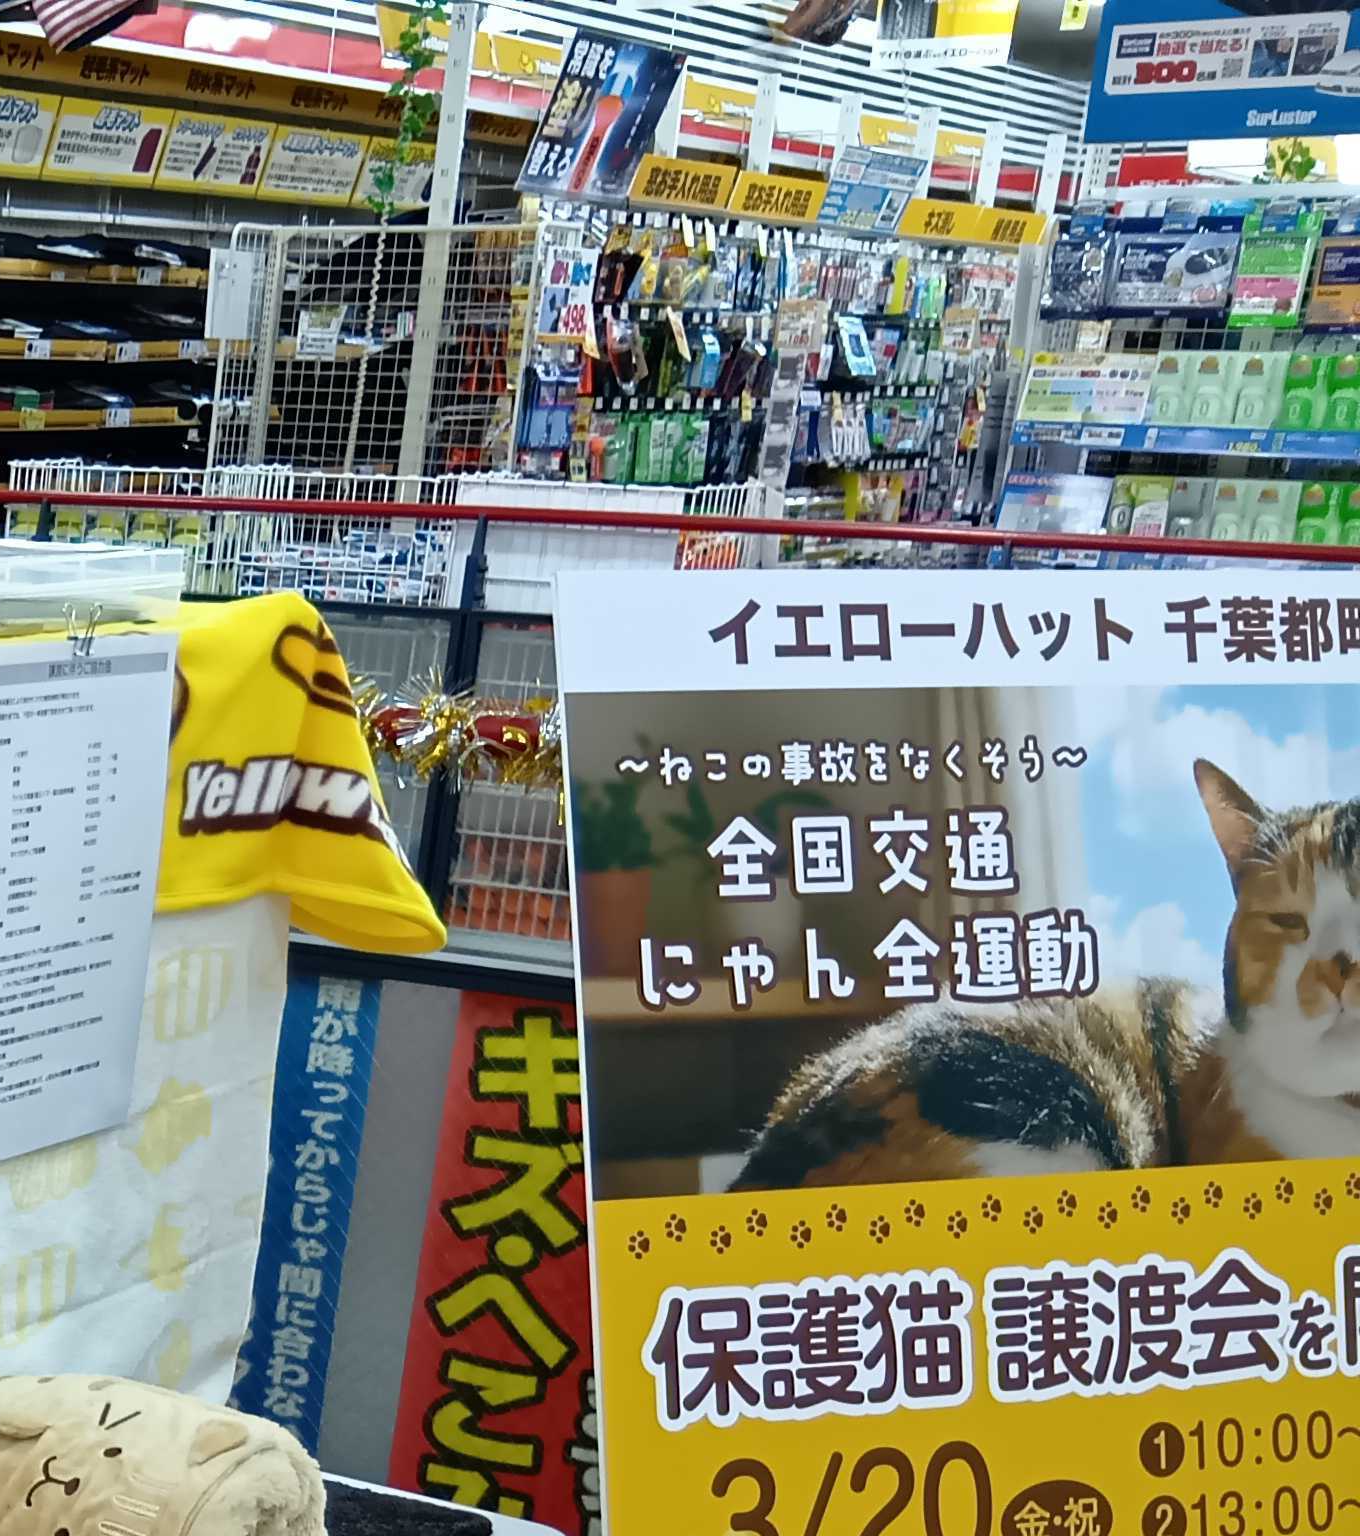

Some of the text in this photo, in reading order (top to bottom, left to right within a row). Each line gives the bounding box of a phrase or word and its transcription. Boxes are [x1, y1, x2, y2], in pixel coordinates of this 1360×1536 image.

[1246, 109, 1318, 128] SurLuster
[708, 597, 1134, 665] イエローハット
[617, 737, 1088, 788] ～ねこの事故をなくそう～
[706, 810, 1017, 899] 全国交通
[640, 909, 1100, 1007] にゃん全運動
[648, 1256, 1360, 1421] 保護猫 譲渡会を
